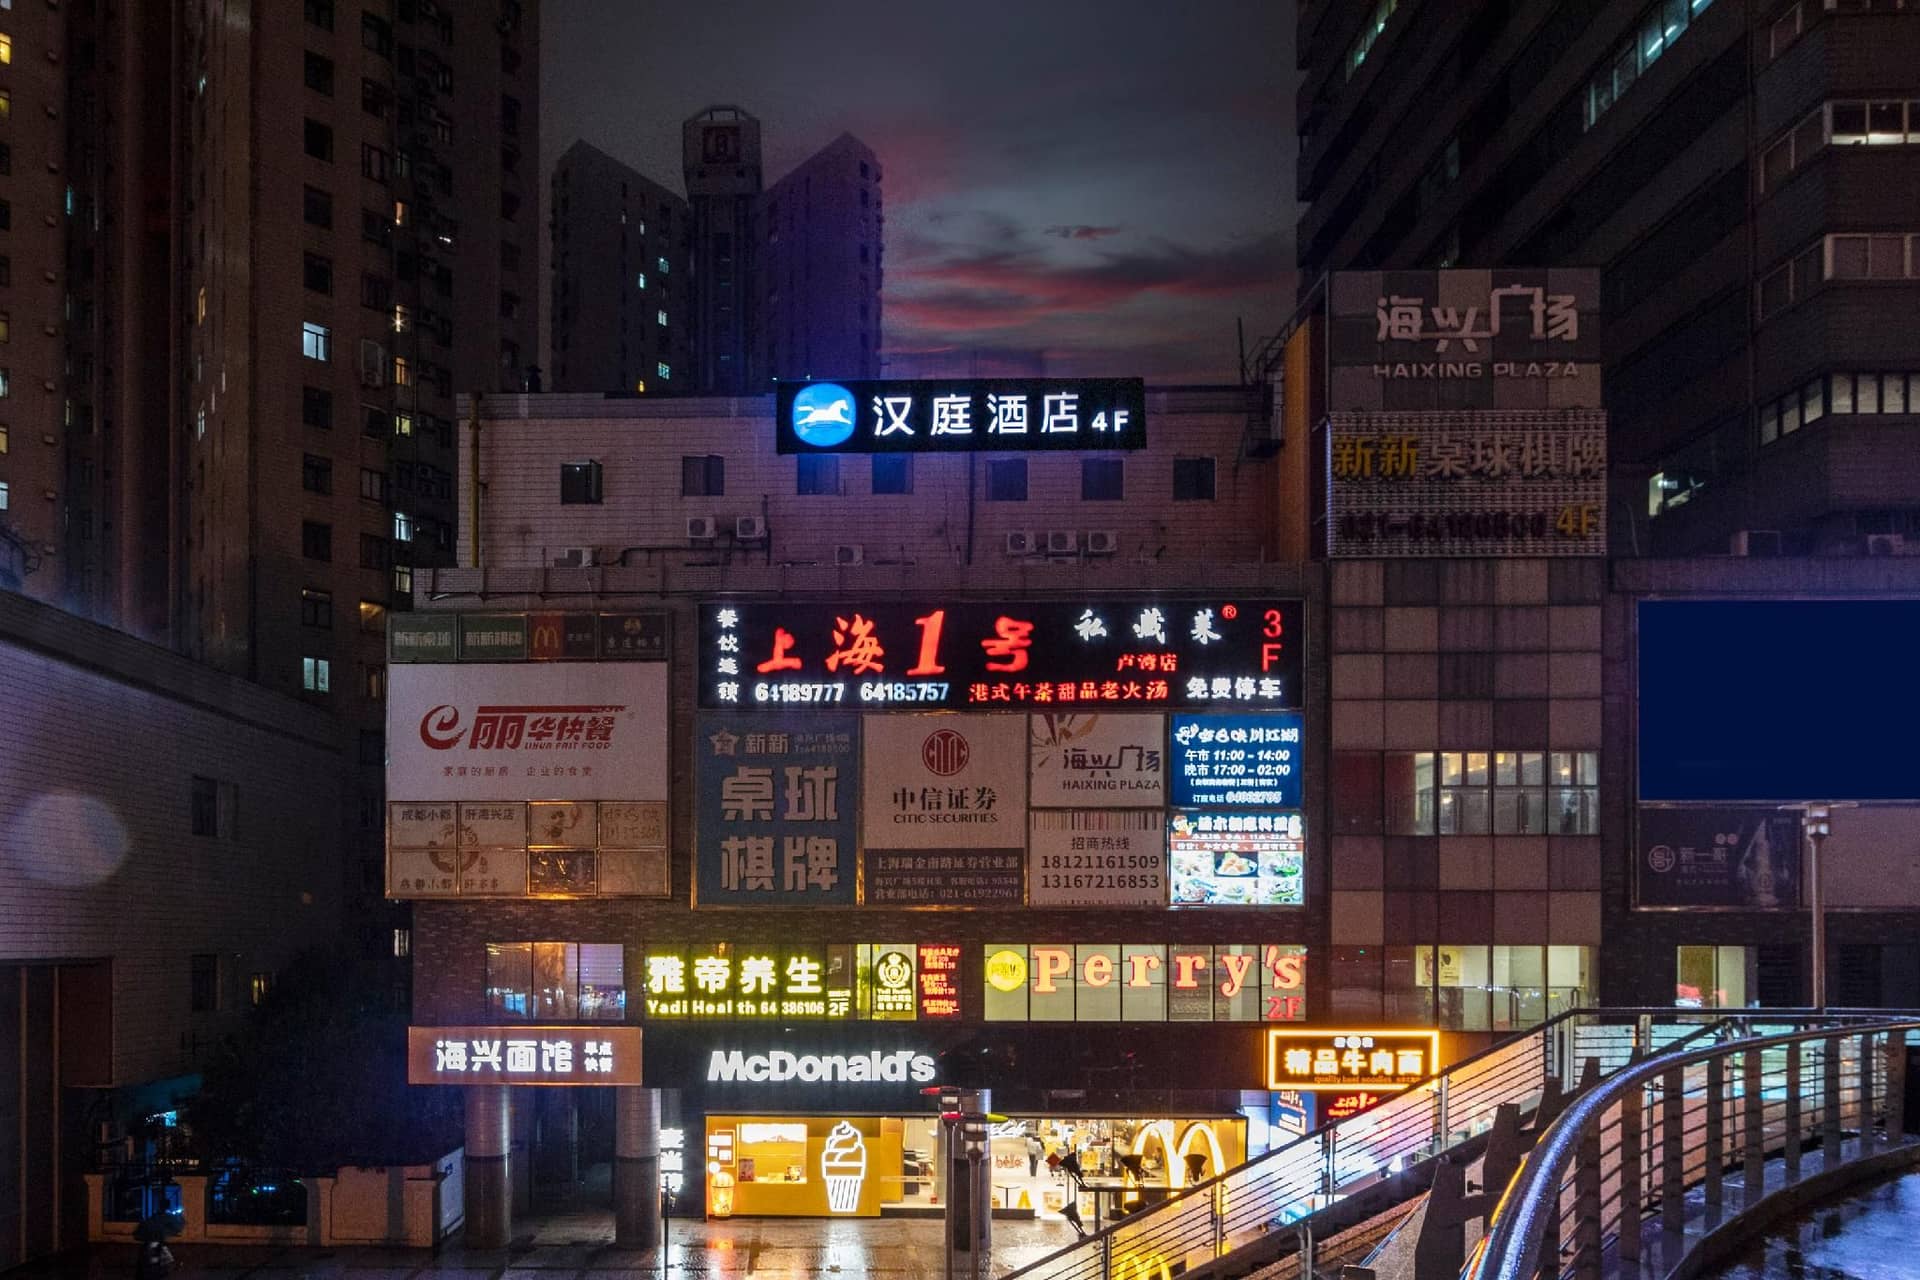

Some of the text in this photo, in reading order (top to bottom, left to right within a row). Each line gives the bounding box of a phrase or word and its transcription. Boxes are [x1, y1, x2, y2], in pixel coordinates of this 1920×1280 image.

[1376, 284, 1578, 352] 海兴广场
[1374, 362, 1579, 378] HAIXING PLAZA
[872, 391, 1129, 436] 汉庭酒店 4F
[1556, 503, 1599, 536] 4F
[756, 610, 1034, 675] 上海1号
[1117, 653, 1178, 673] 卢湾店
[755, 682, 950, 702] 64189777 64185757
[969, 680, 1169, 702] 港式午茶甜品老火汤
[1186, 676, 1282, 700] 免费停车
[468, 705, 627, 750] 丽华快餐
[744, 732, 790, 754] 新新
[1184, 749, 1210, 761] 午市
[1213, 750, 1245, 761] 11:00
[1256, 750, 1290, 761] 14:00
[1063, 745, 1161, 777] 海兴广场
[1184, 763, 1210, 776] 晚市
[1212, 764, 1246, 776] 17:00
[1256, 764, 1291, 776] 02:00
[721, 766, 839, 821] 桌球
[1063, 780, 1161, 790] HAIXING PLAZA
[893, 787, 998, 812] 中信证券
[893, 813, 999, 824] CITIC SECURITIES
[1071, 837, 1130, 850] 招商热线
[721, 835, 839, 892] 棋牌
[1041, 855, 1160, 870] 18121161509
[1041, 875, 1160, 889] 13167216853
[648, 956, 822, 994] 雅帝养生
[1034, 945, 1304, 998] Perry's
[648, 1000, 688, 1014] Yadi
[828, 1001, 849, 1016] 2F
[1266, 996, 1304, 1020] 2F
[436, 1040, 573, 1072] 海兴面馆
[707, 1050, 936, 1082] McDonald's
[1284, 1048, 1424, 1076] 精品牛肉面
